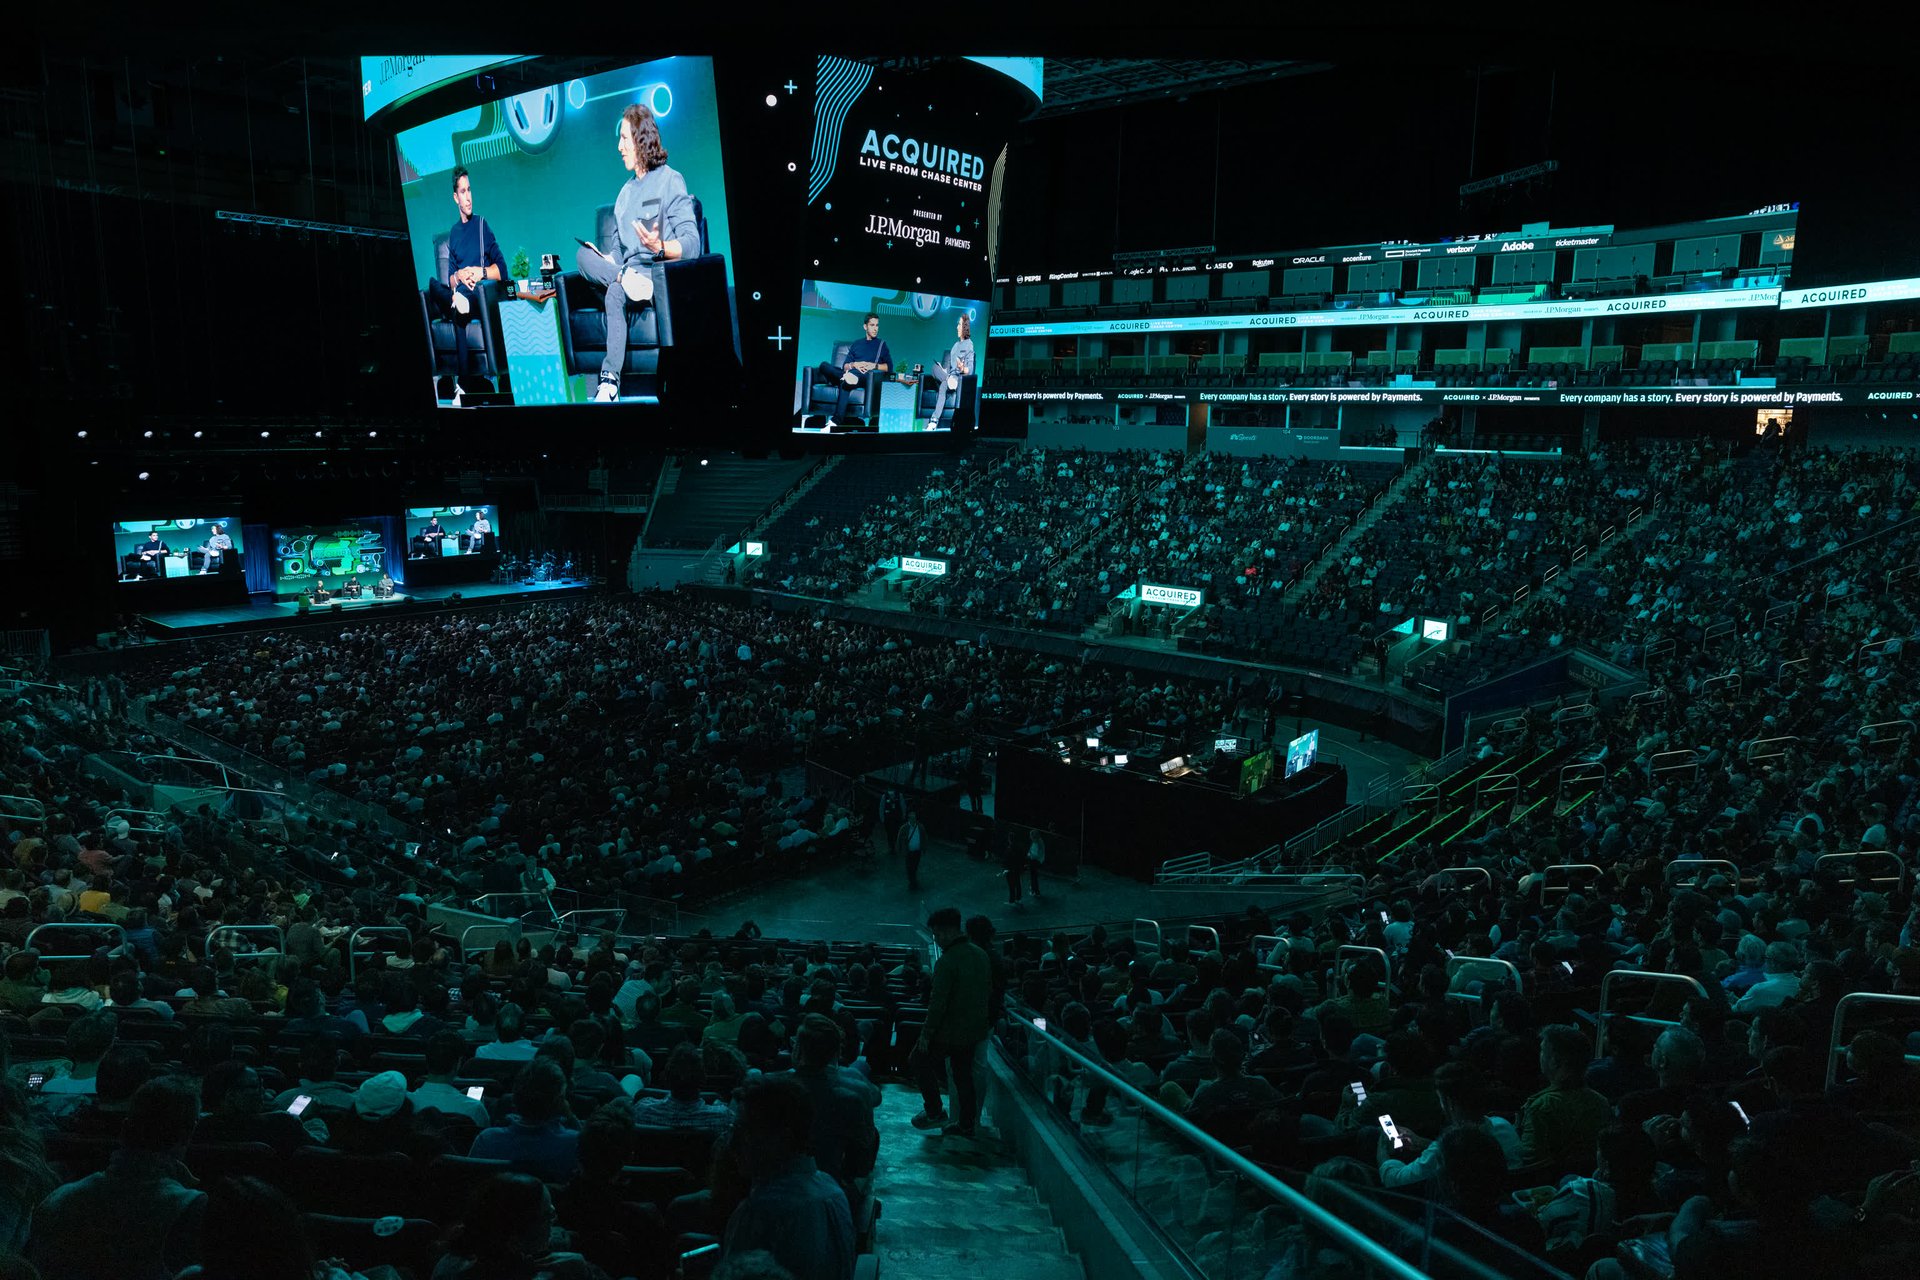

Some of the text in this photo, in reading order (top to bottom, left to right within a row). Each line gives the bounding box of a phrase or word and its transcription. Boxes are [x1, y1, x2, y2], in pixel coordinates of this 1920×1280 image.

[860, 129, 985, 181] ACQUIRED
[859, 156, 982, 192] LIVE FROM CHASE CENTER
[912, 209, 936, 220] PRESENTED
[864, 214, 971, 250] J.P.Morgan PAYMENTS
[1501, 242, 1535, 252] Adobe
[1555, 238, 1600, 247] ticketmaster
[1446, 246, 1474, 254] verizon
[1252, 259, 1274, 268] Rakuten
[1292, 256, 1326, 264] ORACLE
[1342, 255, 1372, 263] accenture
[1049, 272, 1079, 280] RingCentral
[1801, 288, 1867, 304] ACQUIRED
[1606, 299, 1667, 312] ACQUIRED
[1413, 310, 1469, 320] ACQUIRED
[1249, 316, 1297, 326] ACQUIRED
[990, 327, 1025, 336] ACQUIRED
[1109, 322, 1150, 331] ACQUIRED
[1008, 392, 1022, 400] Every
[1022, 392, 1036, 400] story
[1042, 392, 1066, 400] powered
[1066, 392, 1074, 400] by
[1074, 392, 1104, 400] Payments.
[1200, 392, 1218, 402] Every
[1218, 393, 1248, 402] company
[1249, 392, 1262, 400] has
[1268, 393, 1288, 402] story.
[1289, 393, 1310, 402] Every
[1310, 393, 1330, 402] story
[1330, 392, 1337, 400] is
[1338, 392, 1370, 402] powered
[1371, 392, 1381, 402] by
[1382, 393, 1423, 402] Payments.
[1487, 394, 1522, 402] J.P.Morgan
[1560, 394, 1582, 404] Every
[1584, 394, 1622, 404] company
[1623, 393, 1638, 402] has
[1648, 393, 1674, 404] story.
[1676, 393, 1702, 404] Every
[1703, 392, 1728, 404] story
[1730, 392, 1739, 402] is
[1740, 392, 1782, 404] powered
[1784, 392, 1795, 404] by
[1796, 392, 1844, 404] Payments.
[1867, 392, 1913, 400] ACQUIRED
[905, 560, 943, 571] ACQUIRED
[1146, 588, 1197, 601] ACQUIRED
